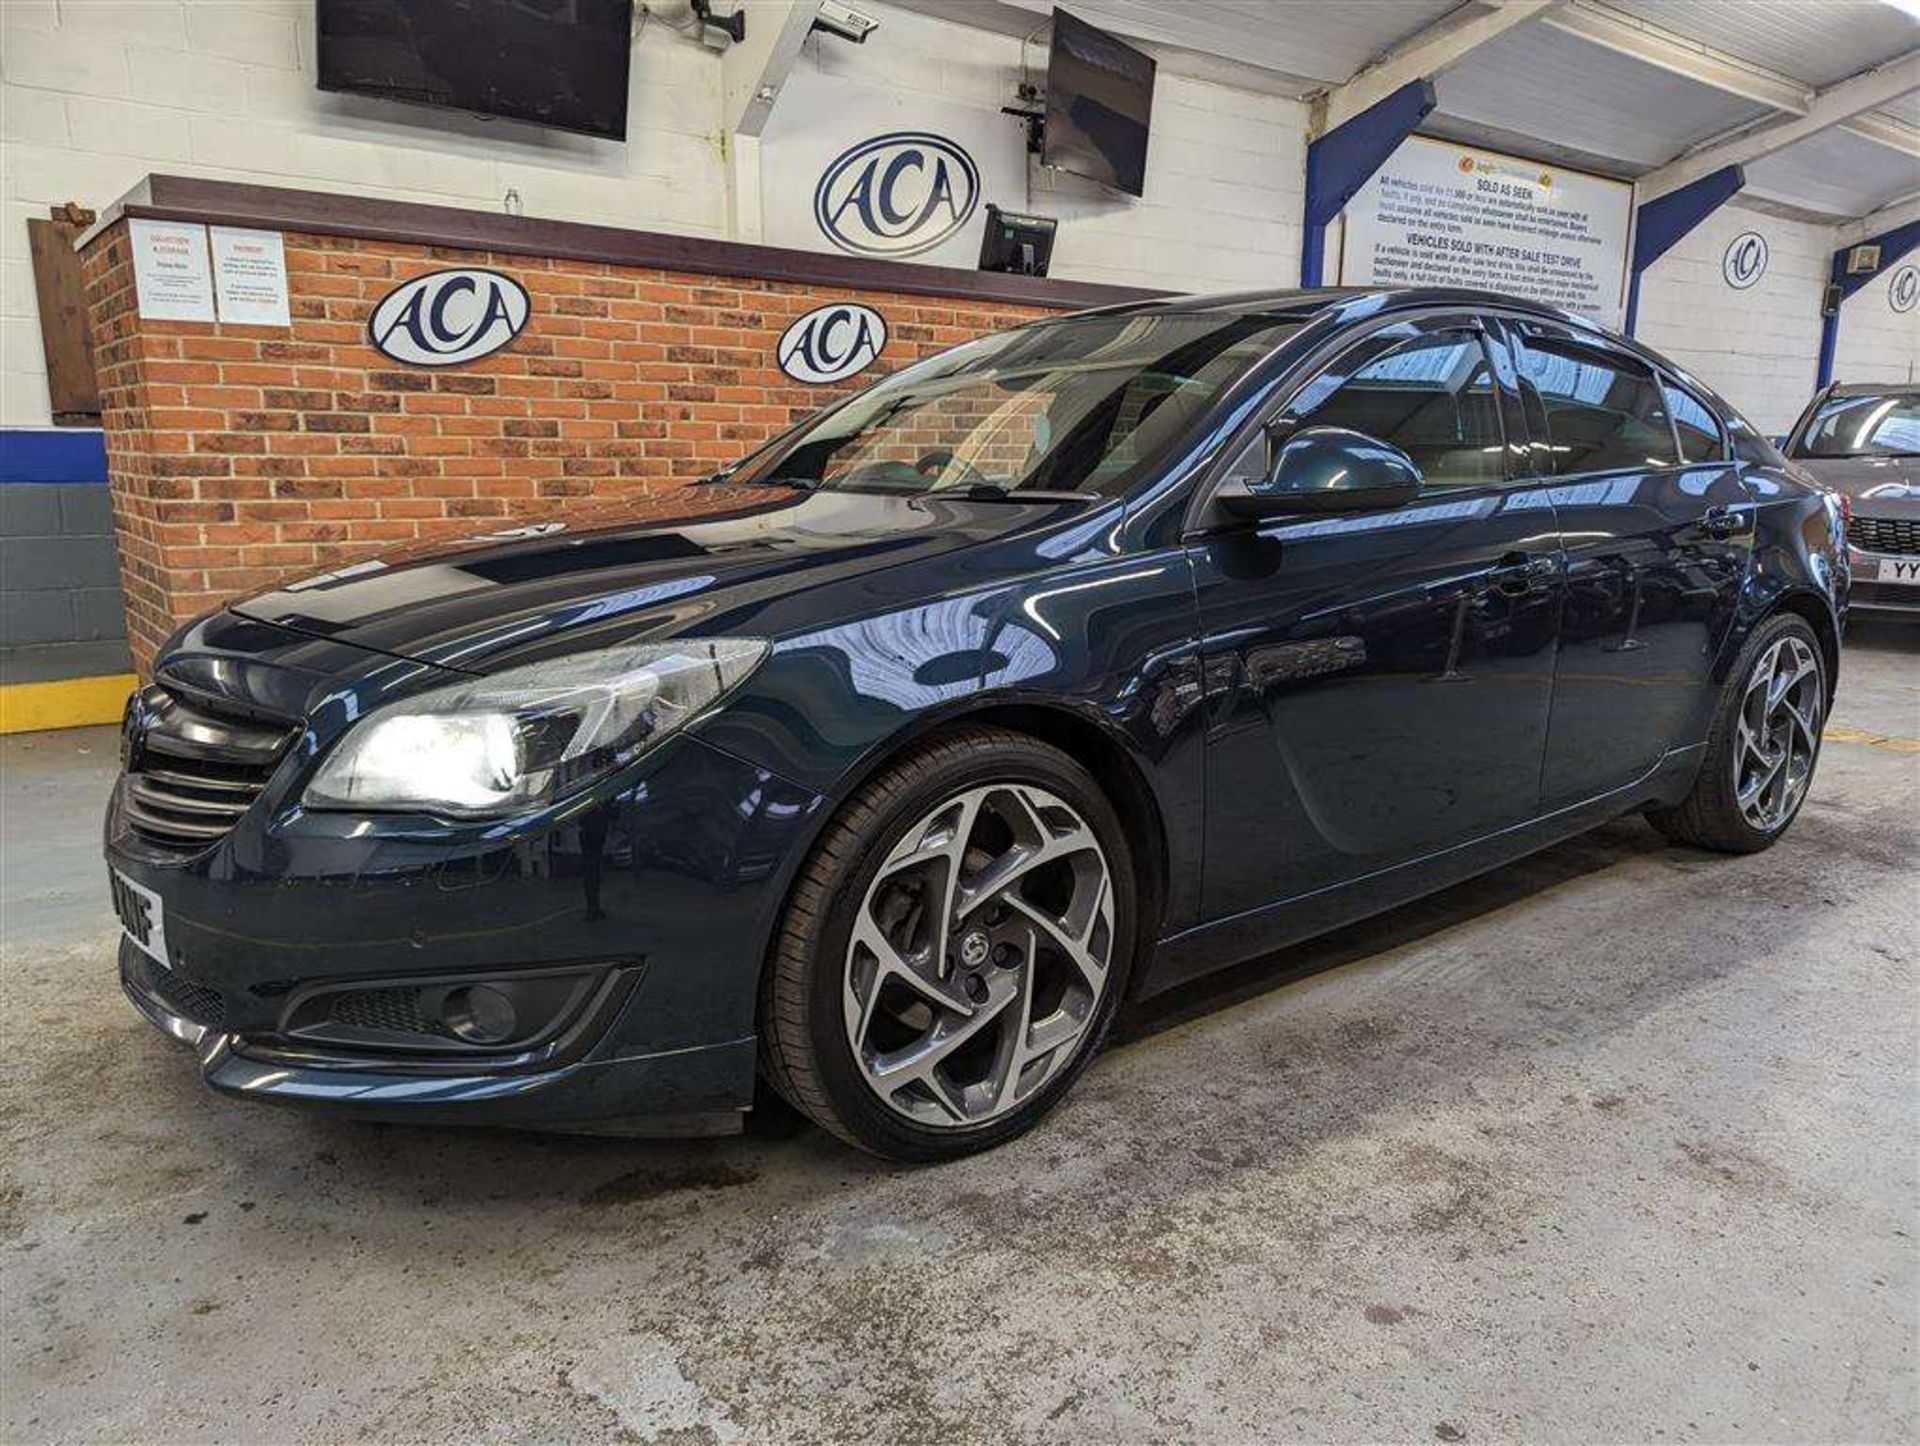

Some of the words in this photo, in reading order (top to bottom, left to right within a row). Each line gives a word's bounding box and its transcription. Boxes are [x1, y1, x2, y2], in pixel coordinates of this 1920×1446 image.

[831, 149, 959, 238] ACA
[1477, 179, 1498, 194] SOLD
[1500, 183, 1511, 196] AS
[1513, 185, 1532, 200] SEEN
[1406, 232, 1449, 249] VEHICLES
[1450, 239, 1472, 253] SOLD
[1474, 242, 1495, 256] WITH
[1496, 245, 1520, 260] AFTER
[1521, 249, 1540, 263] SALE
[1542, 252, 1560, 266] TEST
[1560, 255, 1582, 269] DRIVE
[378, 276, 516, 354] ACA
[783, 309, 877, 373] ACA
